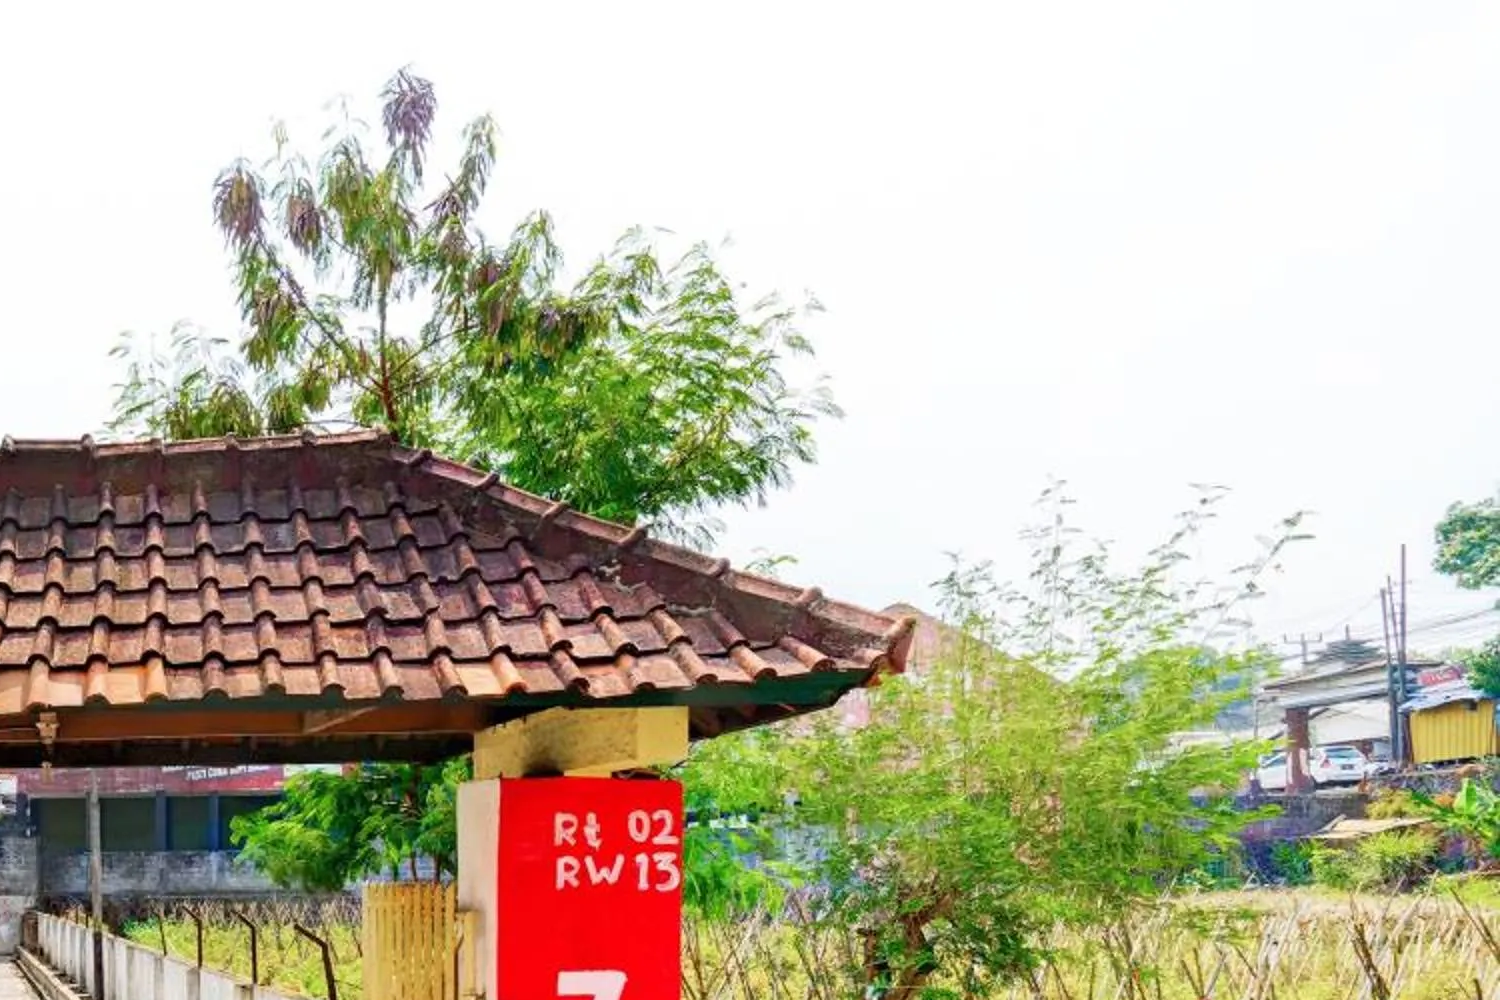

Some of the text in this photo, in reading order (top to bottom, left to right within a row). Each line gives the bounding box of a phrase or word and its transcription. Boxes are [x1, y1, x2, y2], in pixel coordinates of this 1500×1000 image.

[627, 808, 680, 846] 02
[555, 851, 681, 892] RW 13
